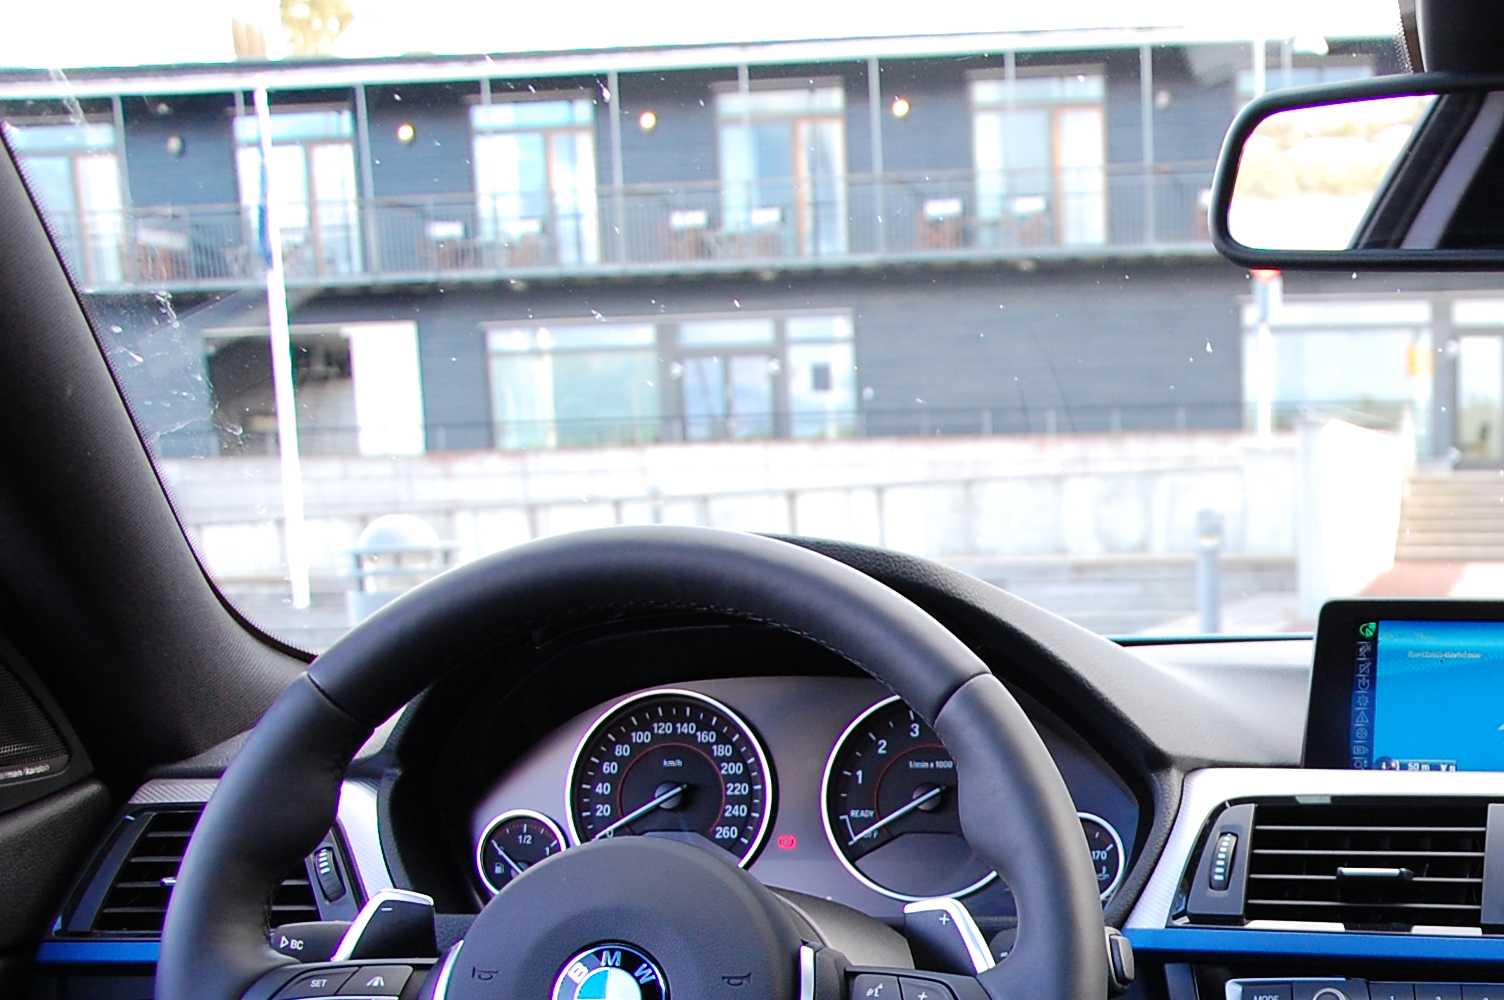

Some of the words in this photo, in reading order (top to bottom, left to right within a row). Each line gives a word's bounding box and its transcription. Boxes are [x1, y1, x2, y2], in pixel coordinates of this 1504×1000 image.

[653, 722, 673, 735] 120
[676, 722, 697, 735] 140
[910, 723, 919, 737] 3
[631, 731, 651, 743] 100
[696, 731, 716, 743] 160
[615, 745, 630, 756] 80
[712, 745, 732, 756] 180
[877, 740, 887, 754] 2
[603, 762, 618, 774] 60
[720, 763, 743, 774] 200
[1408, 762, 1419, 770] 50
[856, 770, 863, 784] 1
[595, 783, 611, 795] 40
[726, 783, 749, 795] 220
[595, 804, 611, 816] 20
[724, 804, 747, 816] 240
[715, 826, 738, 839] 260
[518, 835, 532, 844] 1/2
[1092, 850, 1107, 860] 170
[290, 939, 304, 950] BC
[567, 950, 656, 985] BMW
[311, 979, 327, 987] SET
